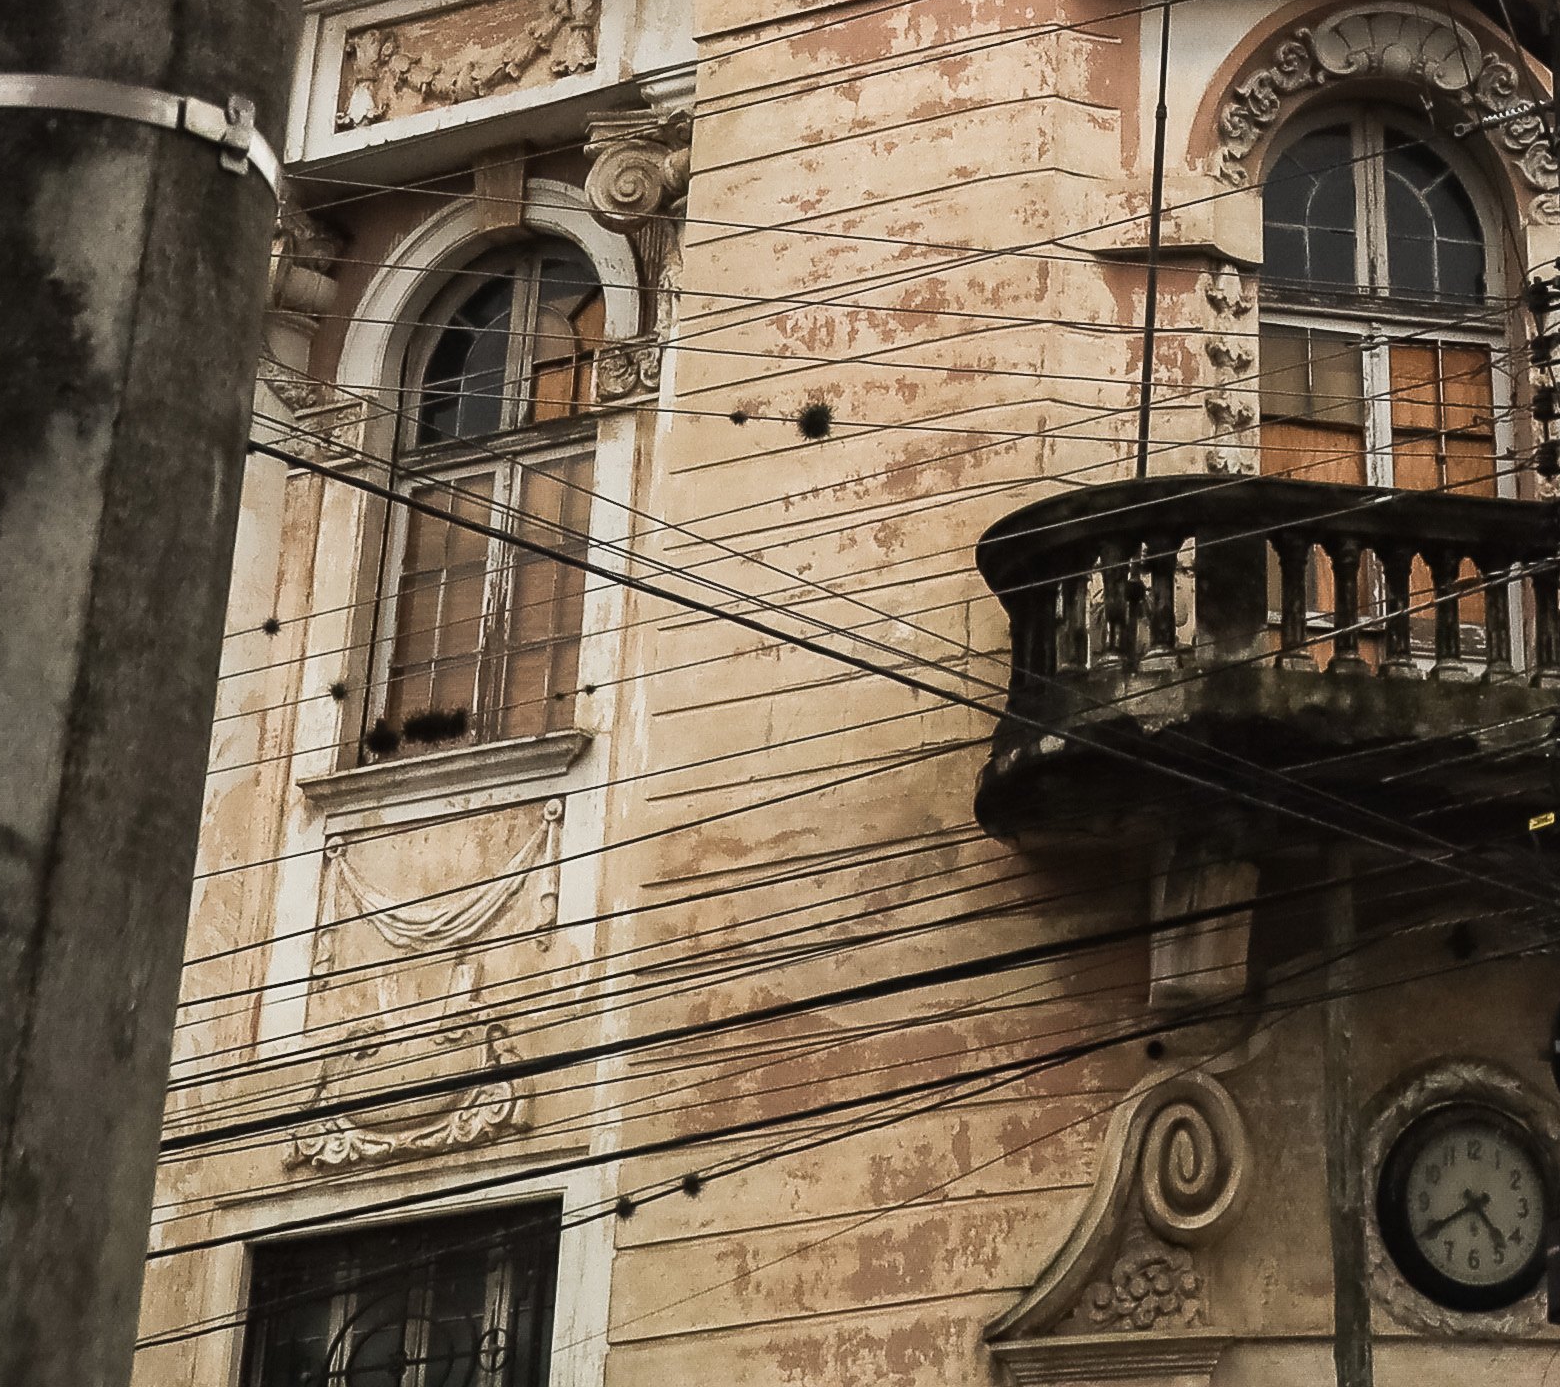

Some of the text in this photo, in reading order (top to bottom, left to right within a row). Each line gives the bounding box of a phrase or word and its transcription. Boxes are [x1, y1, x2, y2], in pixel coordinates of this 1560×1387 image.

[1467, 1139, 1481, 1161] 12
[1510, 1169, 1521, 1190] 2
[1517, 1198, 1529, 1219] 3
[1468, 1248, 1481, 1270] 6
